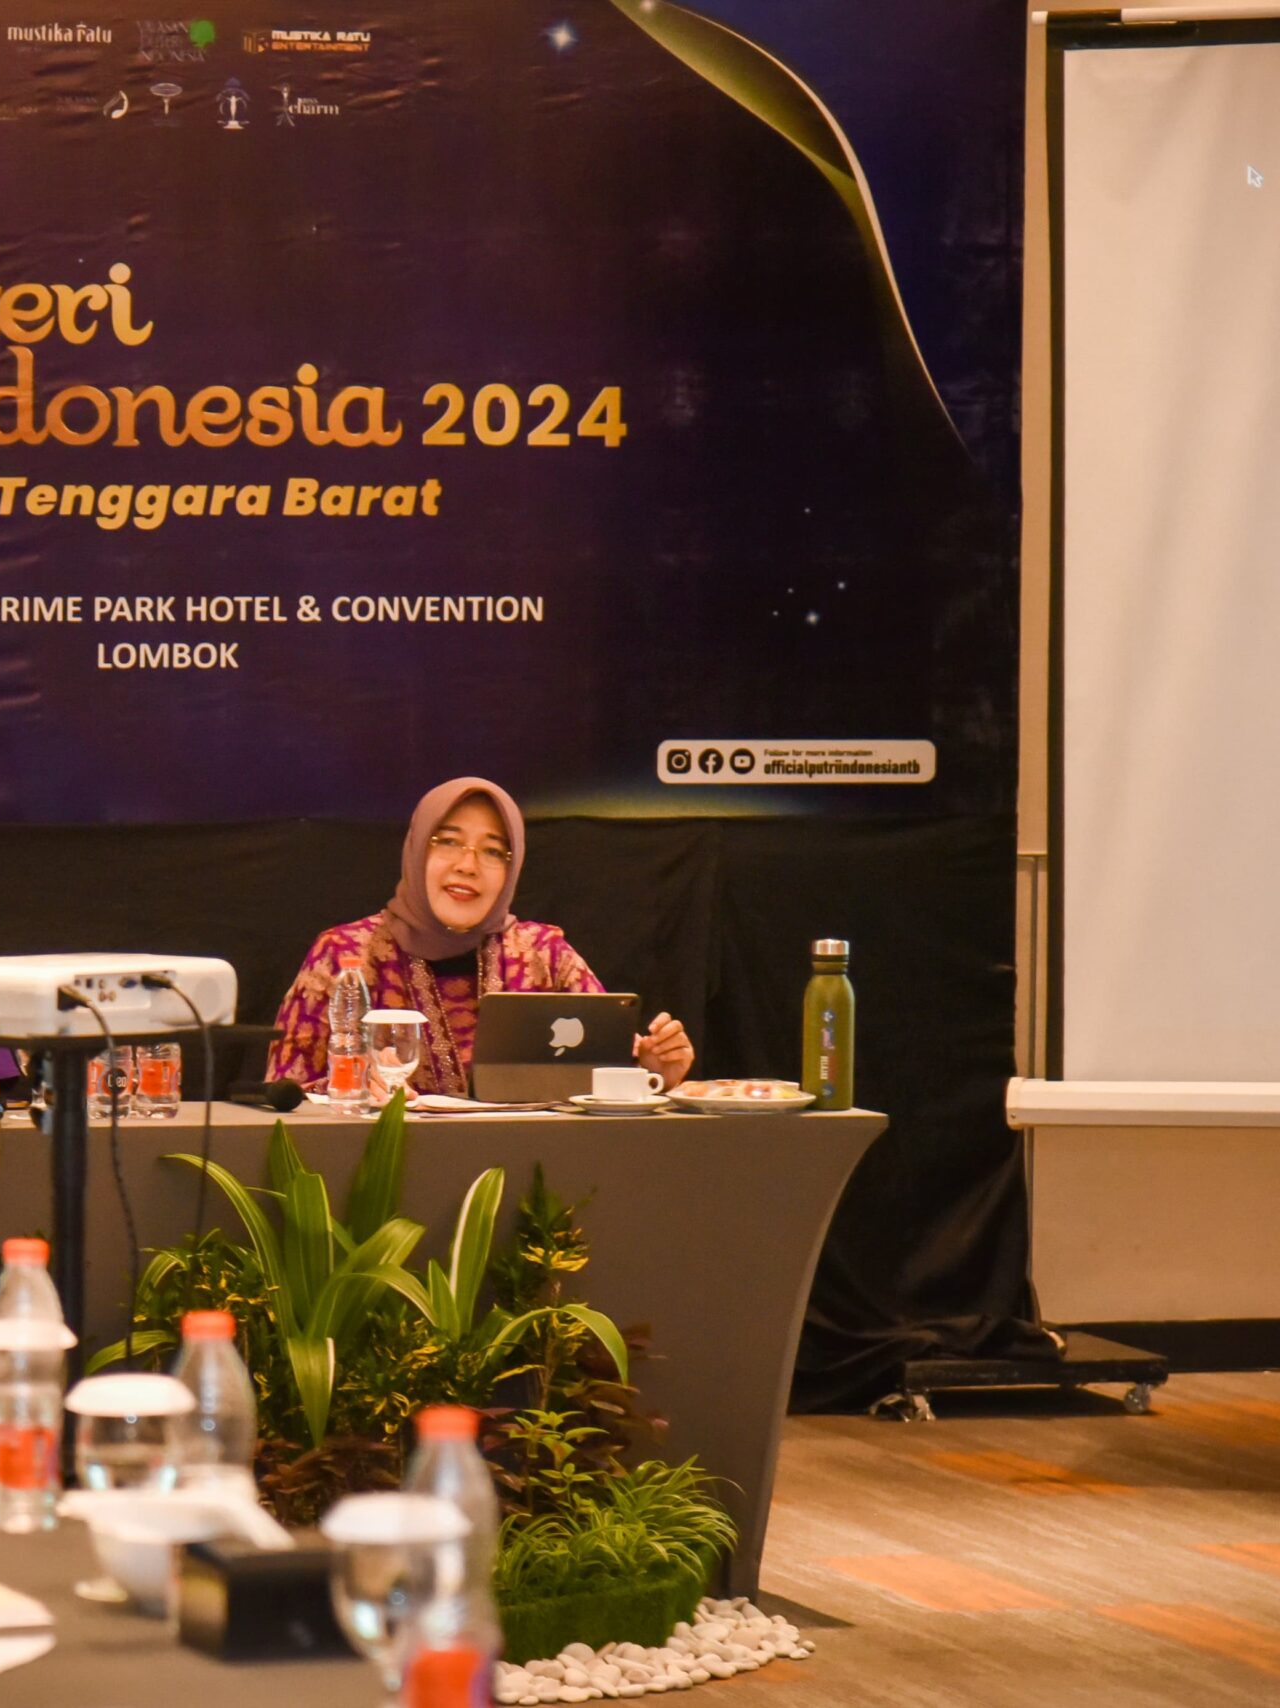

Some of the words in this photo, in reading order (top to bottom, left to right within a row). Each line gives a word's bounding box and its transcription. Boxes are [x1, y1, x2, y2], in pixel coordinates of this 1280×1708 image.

[7, 22, 73, 42] mustika
[271, 30, 331, 41] MUSTIKA
[336, 31, 371, 42] RATU
[422, 382, 628, 447] 2024
[282, 478, 443, 517] Barat
[93, 595, 176, 623] PARK
[185, 595, 288, 622] HOTEL
[296, 594, 322, 622] &
[330, 595, 544, 622] CONVENTION
[96, 641, 239, 669] LOMBOK
